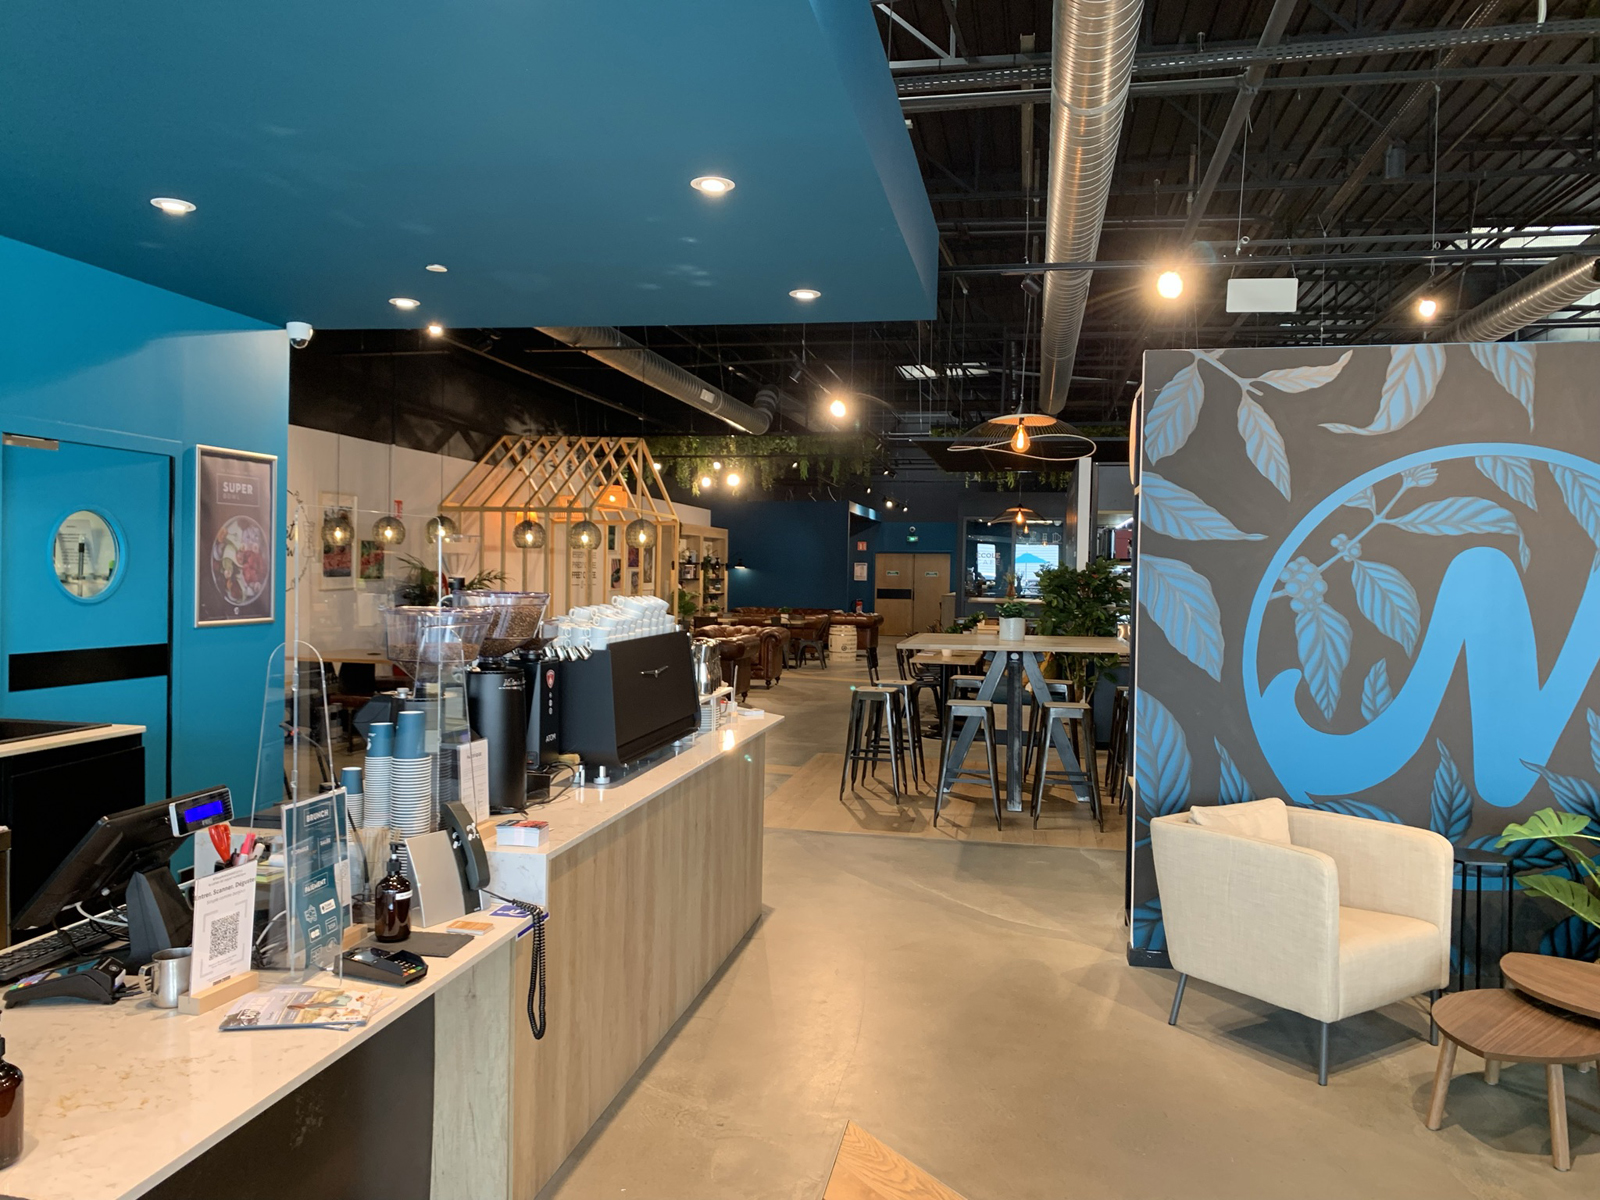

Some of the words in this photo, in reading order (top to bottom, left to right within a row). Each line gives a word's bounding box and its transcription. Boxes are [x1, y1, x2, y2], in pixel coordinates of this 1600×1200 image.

[222, 481, 253, 495] SUPER
[306, 808, 329, 823] BRUNCH
[304, 878, 327, 894] PAIEMENT
